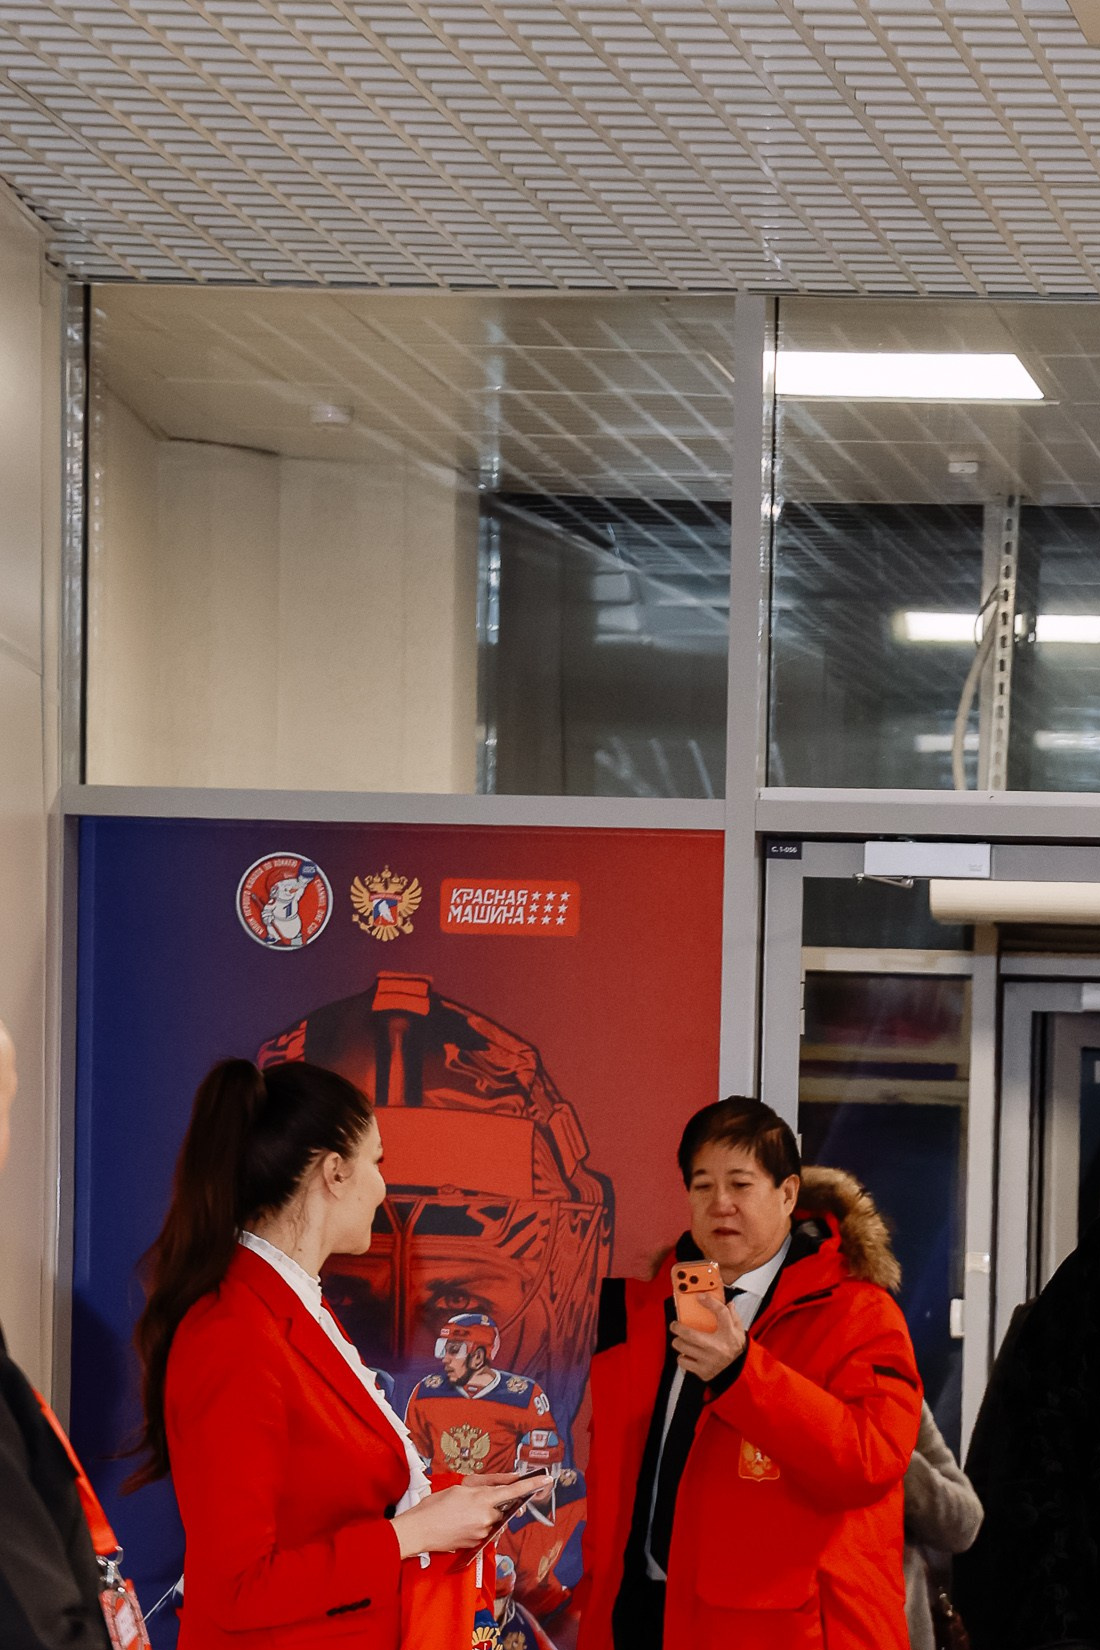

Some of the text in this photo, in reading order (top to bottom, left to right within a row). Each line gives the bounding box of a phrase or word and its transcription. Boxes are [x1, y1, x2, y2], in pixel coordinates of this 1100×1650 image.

[450, 888, 528, 905] КРАСНАЯ
[448, 905, 525, 925] МАШИНА
[533, 1392, 550, 1416] 90
